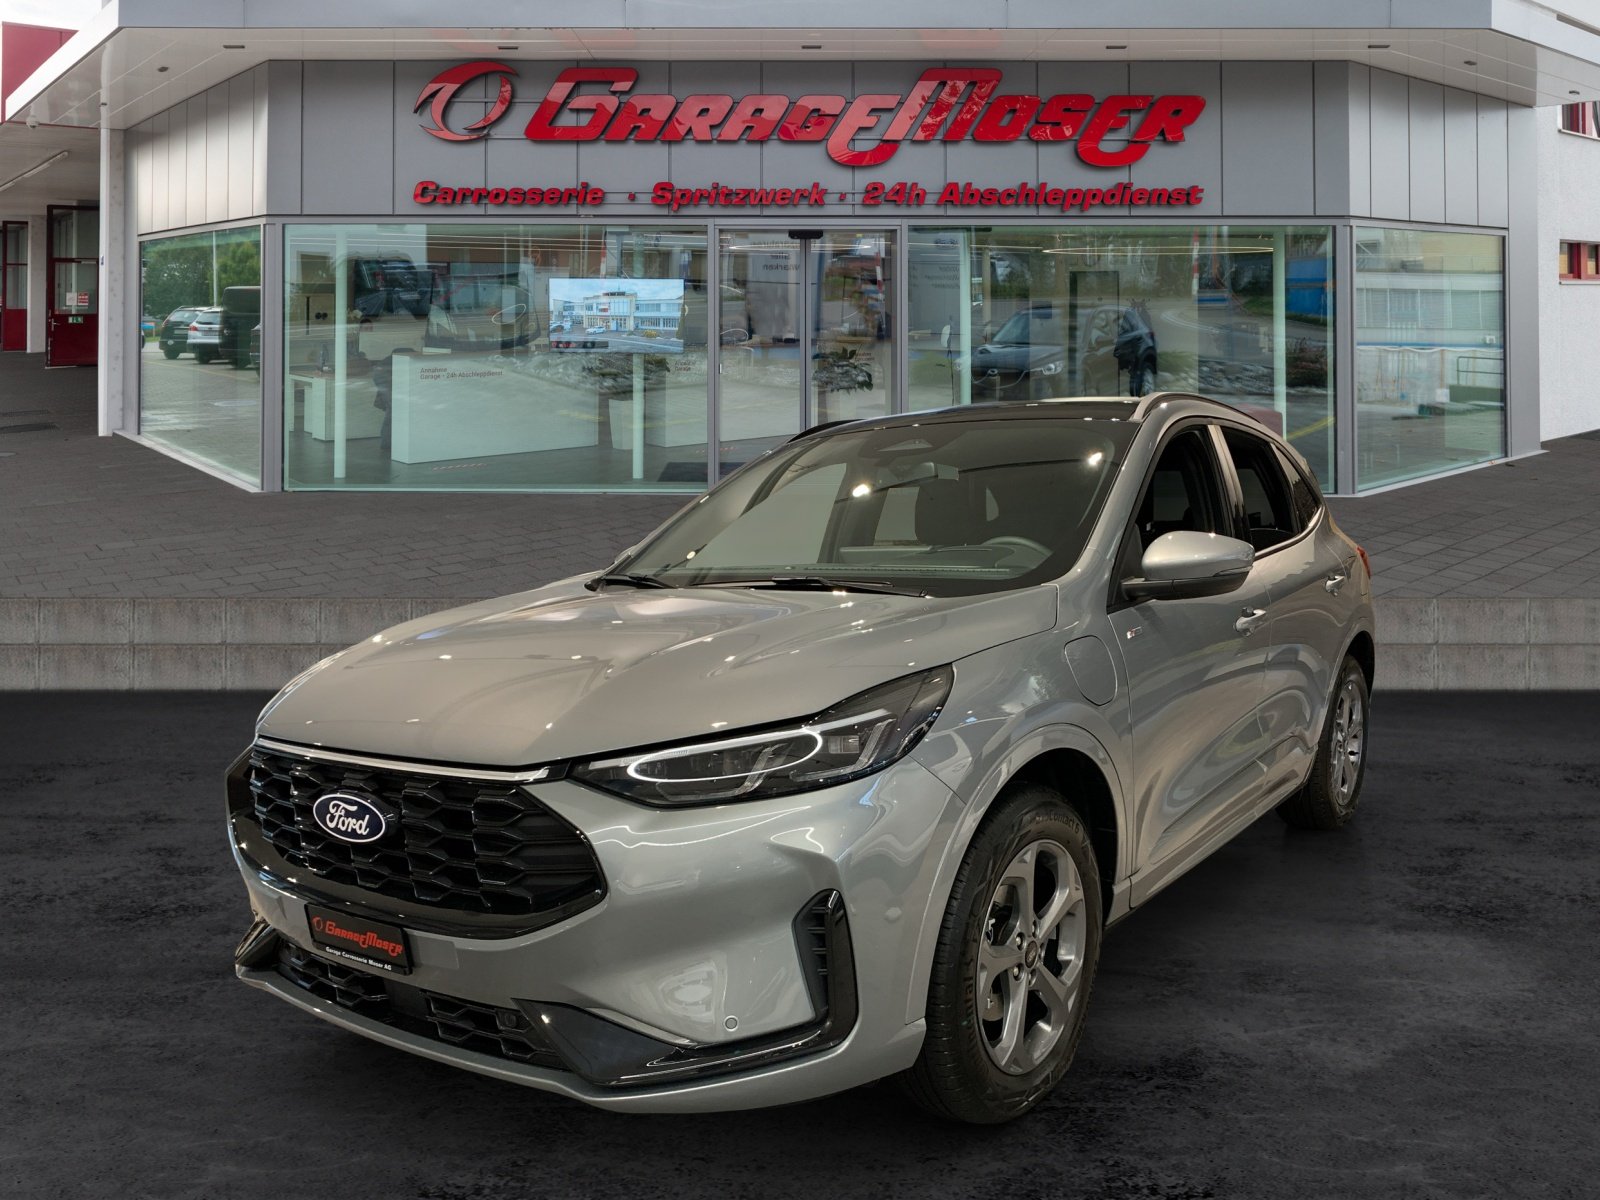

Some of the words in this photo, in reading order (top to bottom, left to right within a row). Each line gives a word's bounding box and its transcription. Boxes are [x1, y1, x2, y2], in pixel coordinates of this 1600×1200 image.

[413, 180, 604, 206] Carrosserie
[651, 181, 827, 212] Spritzwerk
[862, 181, 927, 207] 24h
[937, 181, 1205, 213] Abschleppdienst
[326, 800, 370, 836] Ford
